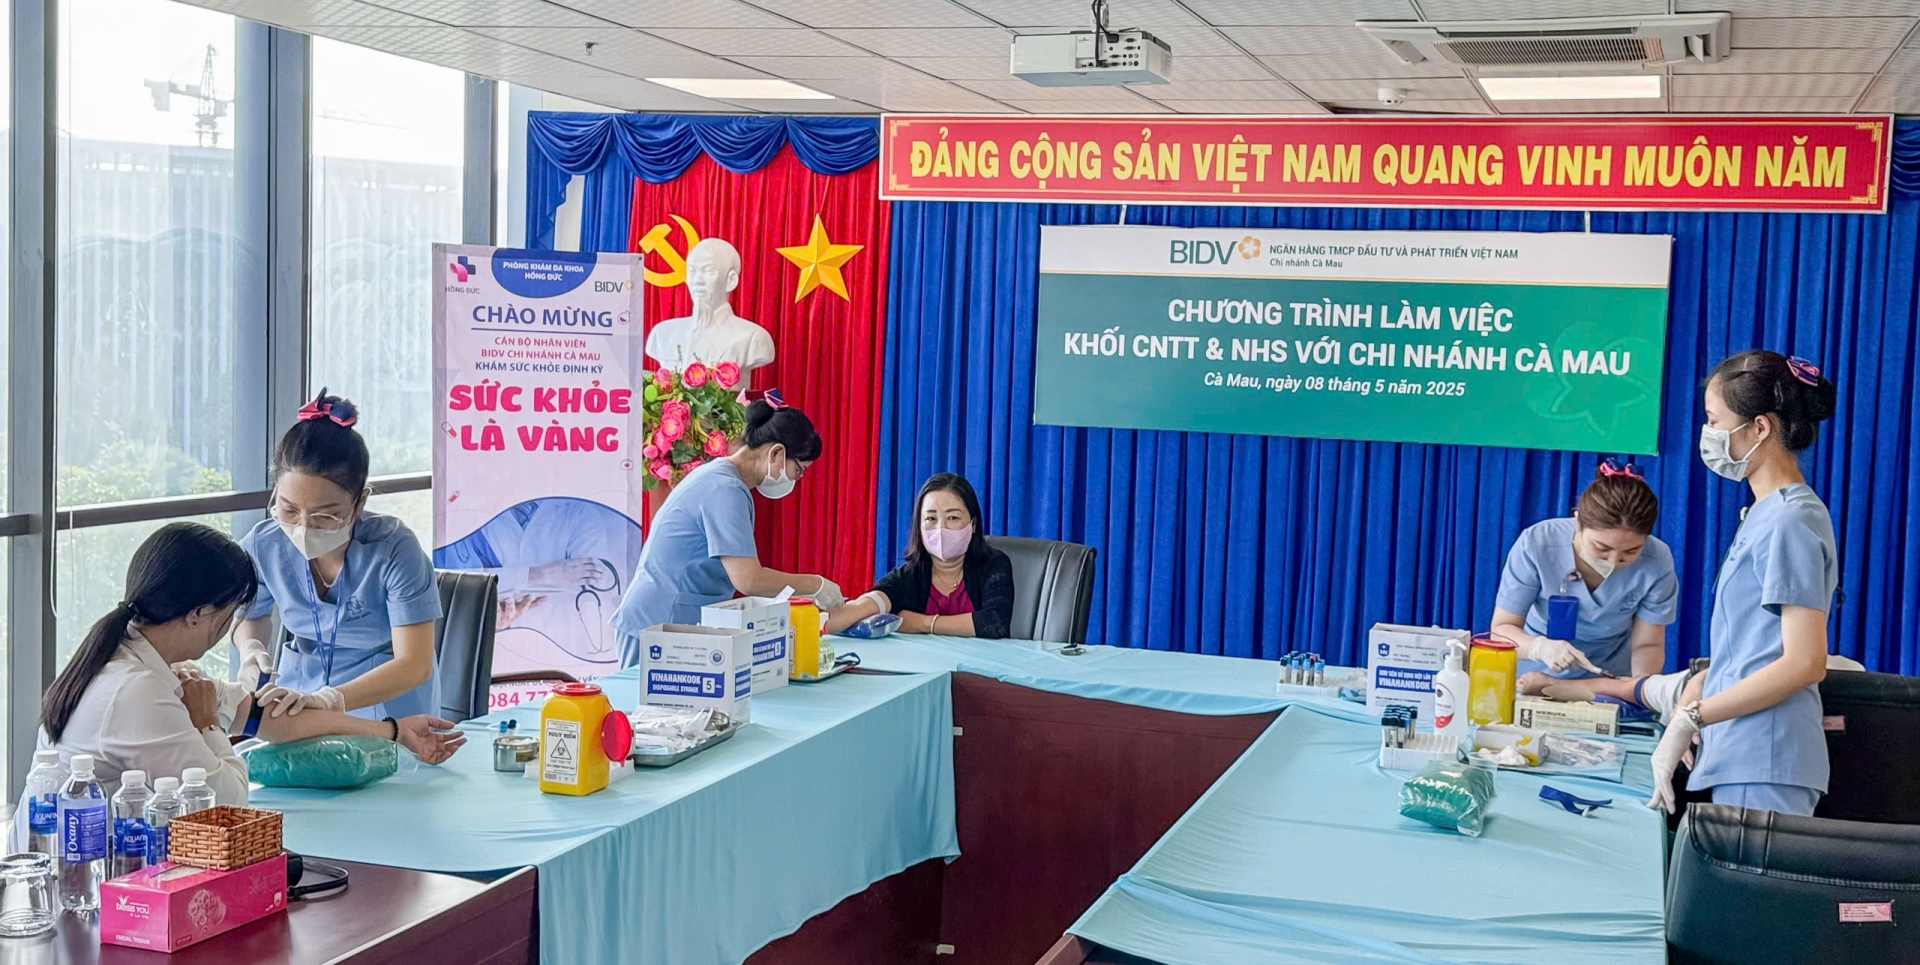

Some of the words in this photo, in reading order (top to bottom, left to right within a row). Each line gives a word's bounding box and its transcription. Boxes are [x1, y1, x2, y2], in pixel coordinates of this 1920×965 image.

[910, 127, 1000, 178] ĐẢNG
[1010, 132, 1102, 189] CỘNG
[1112, 127, 1180, 181] SẢN
[1193, 134, 1272, 193] VIỆT
[1282, 144, 1361, 184] NAM
[1372, 144, 1504, 186] QUANG
[1518, 146, 1611, 186] VINH
[1624, 136, 1742, 188] MUÔN
[1754, 134, 1846, 188] NĂM
[1170, 240, 1238, 264] BIDV
[1270, 243, 1296, 254] NGÂN
[1298, 243, 1326, 256] HÀNG
[1328, 246, 1354, 256] TMCP
[1380, 246, 1394, 256] TƯ
[1394, 245, 1408, 257] VÀ
[1410, 245, 1437, 258] PHÁT
[1470, 246, 1492, 260] VIỆT
[1495, 249, 1518, 258] NAM
[503, 261, 529, 270] PHÒNG
[530, 262, 552, 271] KHÁM
[564, 265, 584, 273] KHOA
[1270, 259, 1283, 267] Chi
[1285, 258, 1310, 267] nhánh
[1312, 258, 1323, 267] Cà
[595, 281, 624, 293] BIDV
[472, 304, 536, 324] CHÀO
[542, 306, 613, 328] MỪNG
[1168, 298, 1282, 325] CHƯƠNG
[1289, 298, 1372, 327] TRÌNH
[1380, 300, 1441, 330] LÀM
[1449, 302, 1514, 336] VIỆC
[495, 336, 515, 345] CÁN
[518, 337, 531, 348] BỘ
[534, 337, 562, 347] NHÂN
[564, 339, 586, 348] VIÊN
[1064, 326, 1125, 357] KHỐI
[1132, 334, 1199, 359] CNTT
[1205, 337, 1224, 361] &
[1231, 338, 1288, 362] NHS
[1295, 336, 1341, 364] VỚI
[1349, 342, 1396, 367] CHI
[1404, 340, 1506, 370] NHÁNH
[1515, 342, 1554, 373] CÀ
[1562, 350, 1630, 375] MAU
[481, 349, 505, 357] BIDV
[526, 350, 561, 359] NHÁNH
[564, 351, 576, 360] CÀ
[475, 361, 507, 371] KHÁM
[510, 361, 530, 372] SỨC
[533, 362, 560, 373] KHỎE
[563, 364, 588, 375] ĐỊNH
[1204, 372, 1223, 387] Cà
[1226, 373, 1262, 390] Mau,
[1265, 375, 1302, 392] ngày
[1304, 377, 1324, 390] 08
[1328, 378, 1370, 395] tháng
[1374, 380, 1385, 393] 5
[1388, 379, 1422, 394] năm
[1425, 382, 1466, 396] 2025
[449, 378, 522, 412] SỨC
[534, 380, 632, 414] KHỎE
[461, 418, 506, 451] LÀ
[517, 419, 619, 452] VÀNG
[651, 672, 701, 684] VINAHANKOOK
[706, 680, 712, 690] 5
[488, 692, 520, 708] 084
[68, 813, 79, 852] Ocany
